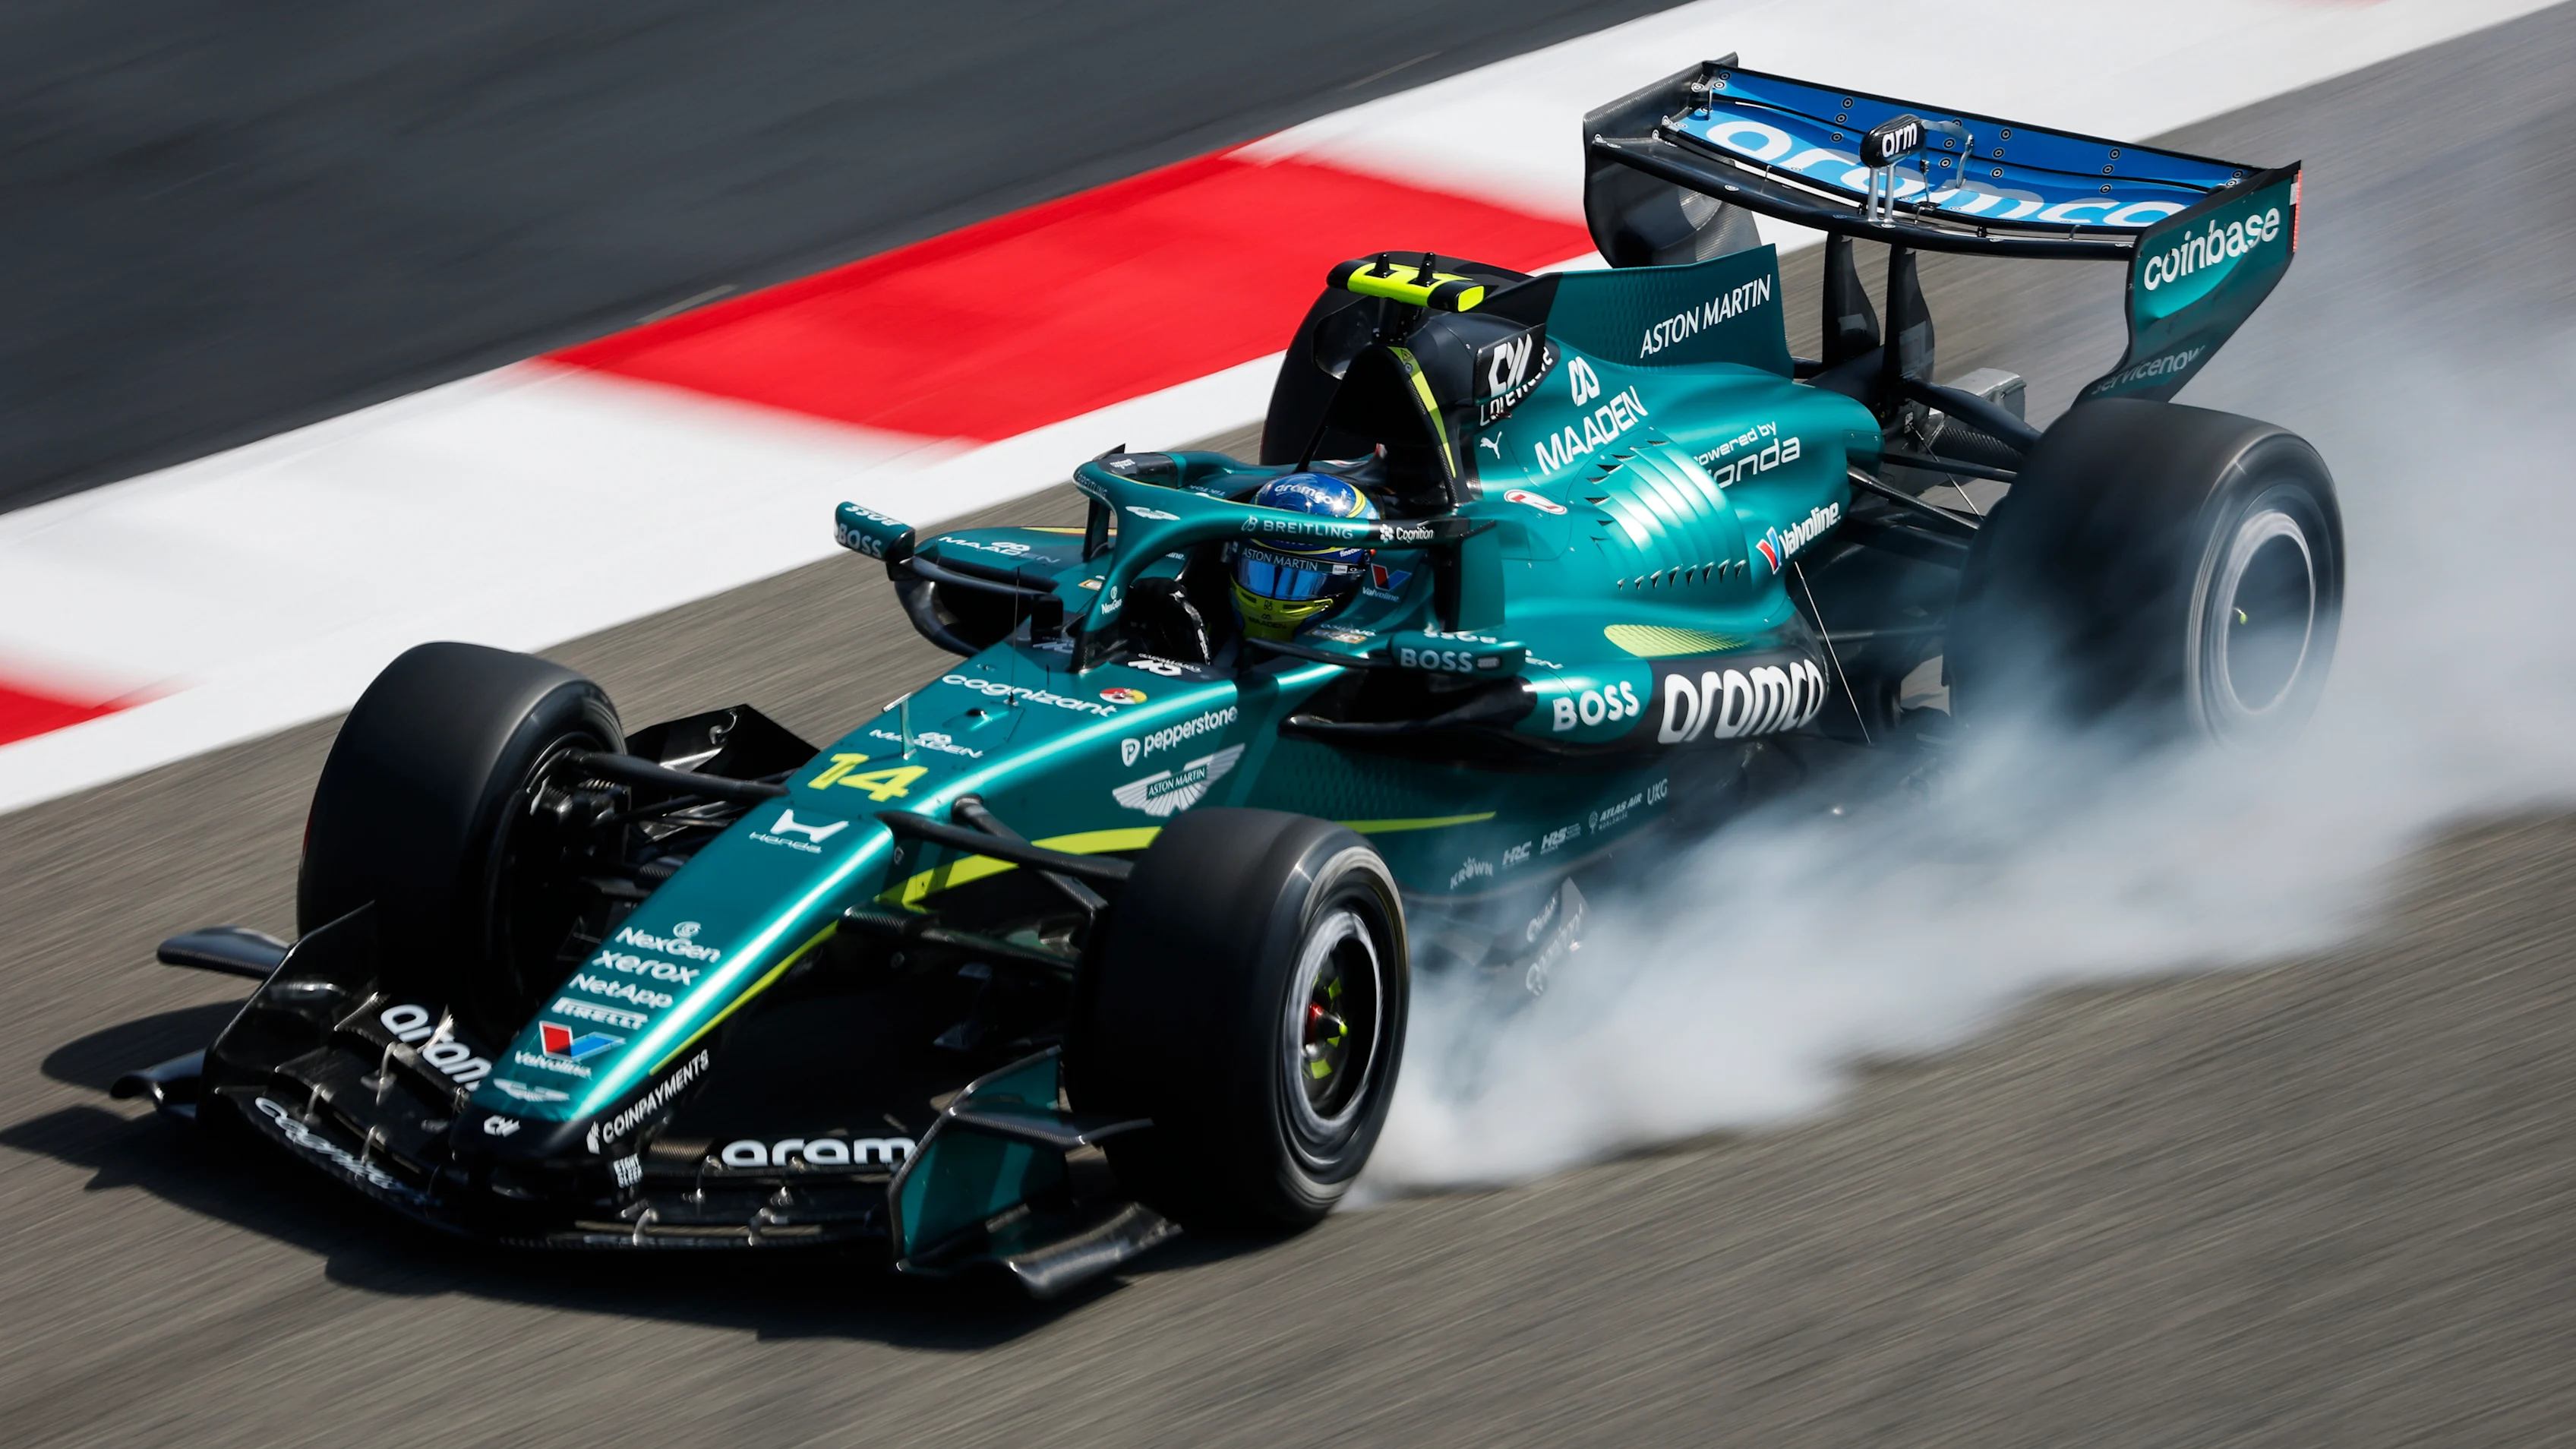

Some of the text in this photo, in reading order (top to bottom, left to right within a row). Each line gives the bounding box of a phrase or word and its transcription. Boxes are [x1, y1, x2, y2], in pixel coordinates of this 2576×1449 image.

[1882, 122, 1918, 158] arm
[1706, 121, 2190, 228] aramco
[2144, 207, 2281, 291] coinbase
[1640, 273, 1771, 359] ASTON MARTIN
[1534, 385, 1649, 476] MAADEN
[1694, 421, 1777, 466] owered by
[1707, 436, 1801, 489] onda
[838, 522, 882, 559] BOSS
[1263, 519, 1353, 539] BREITLING
[1396, 526, 1434, 544] Cognition
[1779, 501, 1839, 559] Valvoline
[938, 536, 1061, 564] MAADEN
[1242, 548, 1318, 571] ASTON MARTIN
[1101, 598, 1122, 615] NexGen
[1362, 586, 1400, 603] Valvoline
[1400, 647, 1473, 674] BOSS
[942, 674, 1118, 718] cognizant
[1552, 680, 1640, 732] BOSS
[1656, 658, 1825, 744] aramco
[1143, 706, 1239, 758] pepperstone
[807, 753, 930, 803] 14
[1148, 767, 1206, 797] ASTON MARTIN
[1646, 778, 1668, 807] UKG
[1599, 792, 1643, 822] ATLAS AIR
[749, 831, 822, 854] Honda
[614, 926, 721, 964] NexGen
[592, 949, 700, 987] xerox
[568, 972, 674, 1009] NetApp
[551, 996, 649, 1031] PIRELLI
[602, 1049, 710, 1144] COINPAYMENTS
